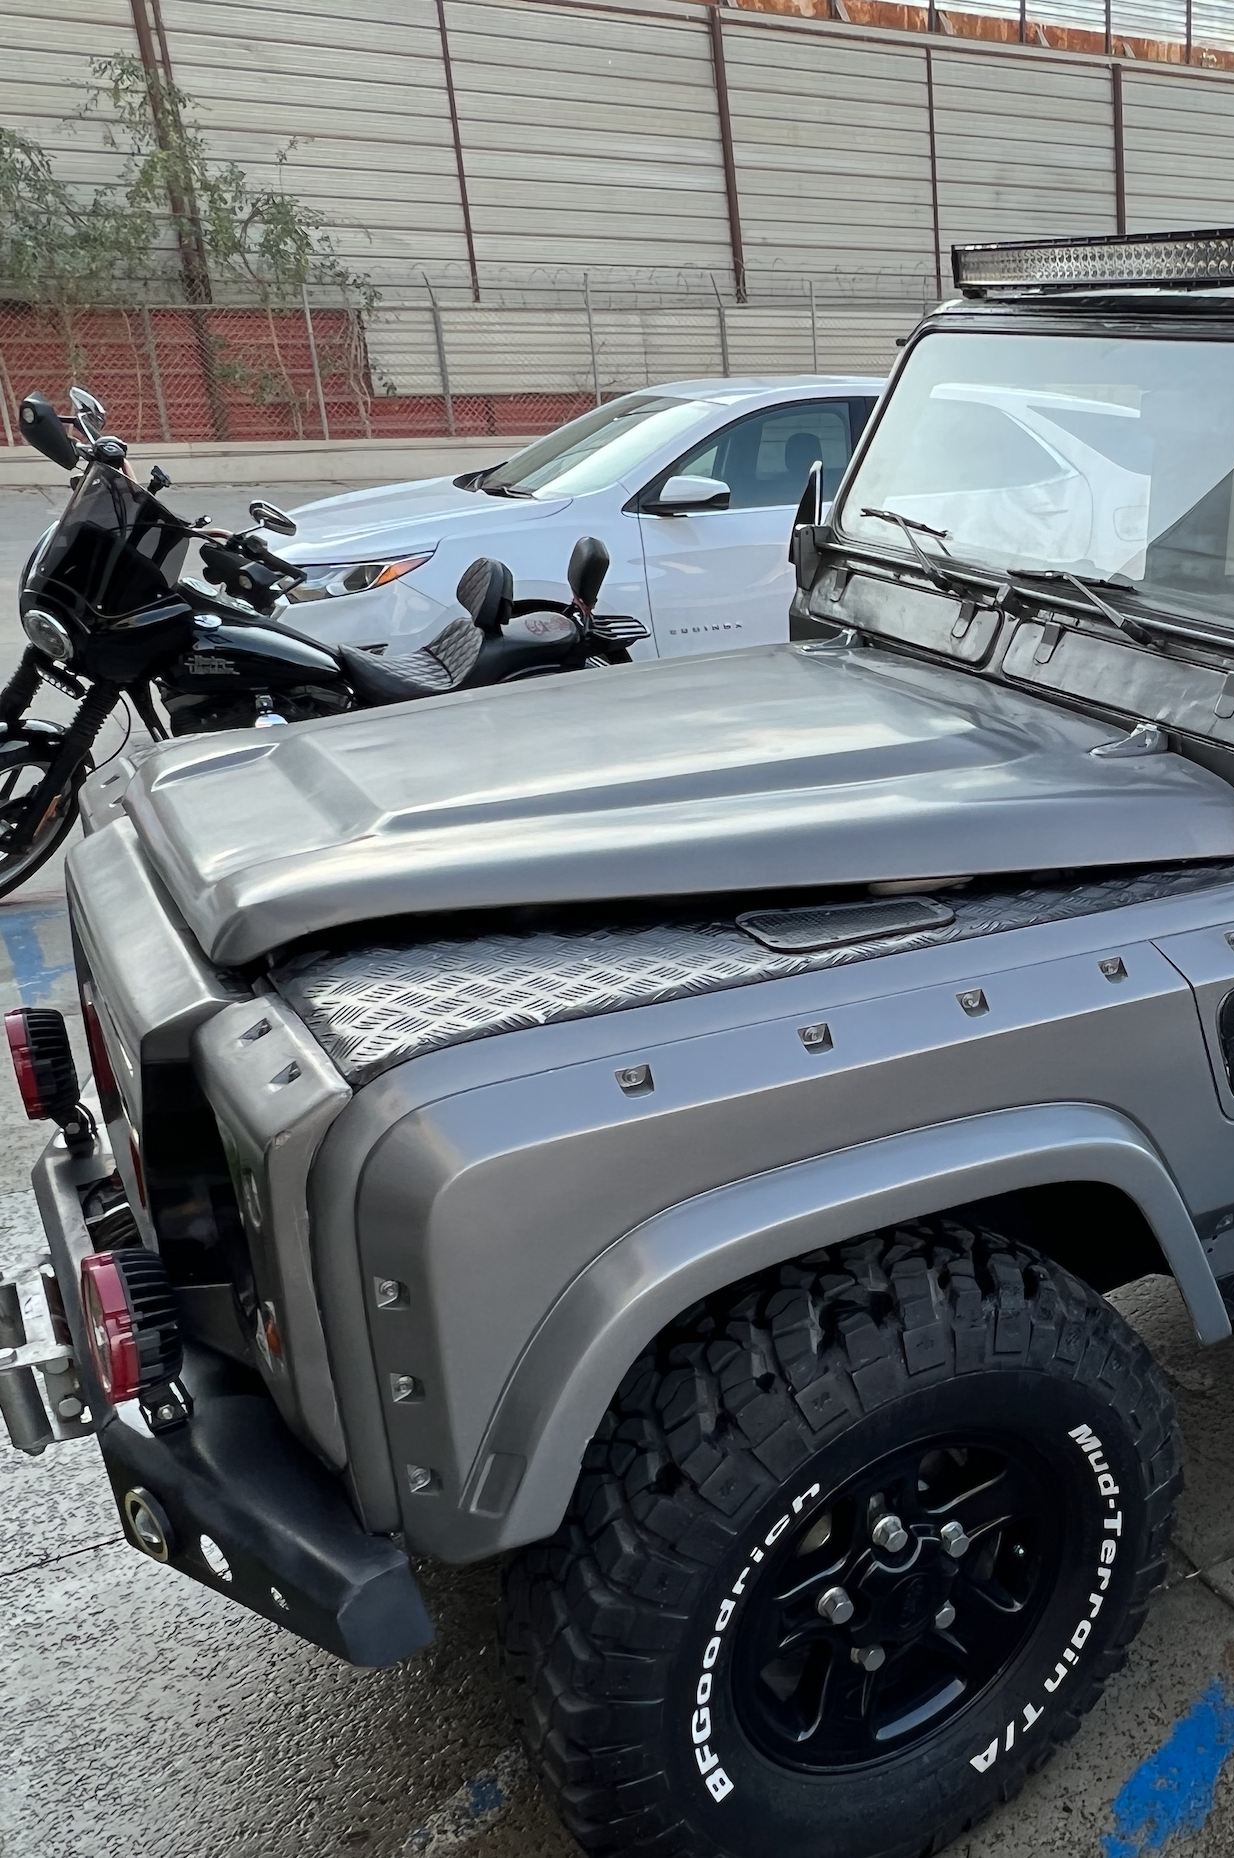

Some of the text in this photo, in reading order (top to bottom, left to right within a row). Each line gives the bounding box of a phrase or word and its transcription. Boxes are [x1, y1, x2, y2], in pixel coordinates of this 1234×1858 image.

[691, 1482, 821, 1802] BFGoodrich
[969, 1423, 1123, 1774] Mud-Terrain T/A
